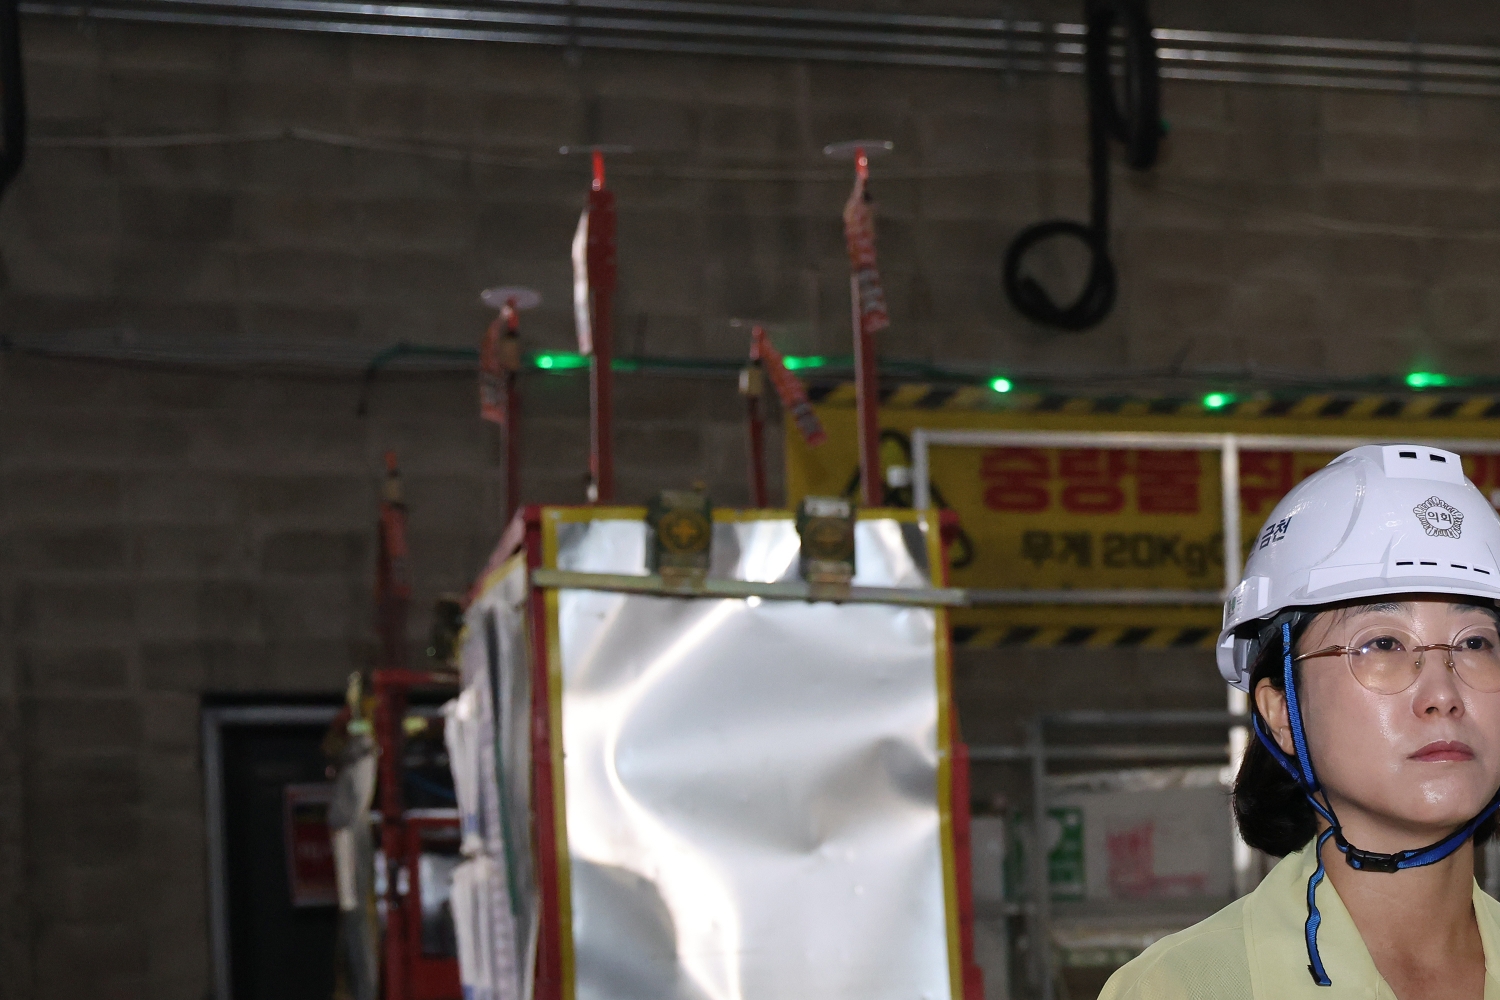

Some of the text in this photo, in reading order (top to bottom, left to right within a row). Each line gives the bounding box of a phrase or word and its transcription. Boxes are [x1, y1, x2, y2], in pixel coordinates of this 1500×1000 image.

[980, 447, 1200, 513] 중량물
[1259, 517, 1292, 550] 금천
[1427, 511, 1452, 525] 의회
[1021, 530, 1091, 567] 무게
